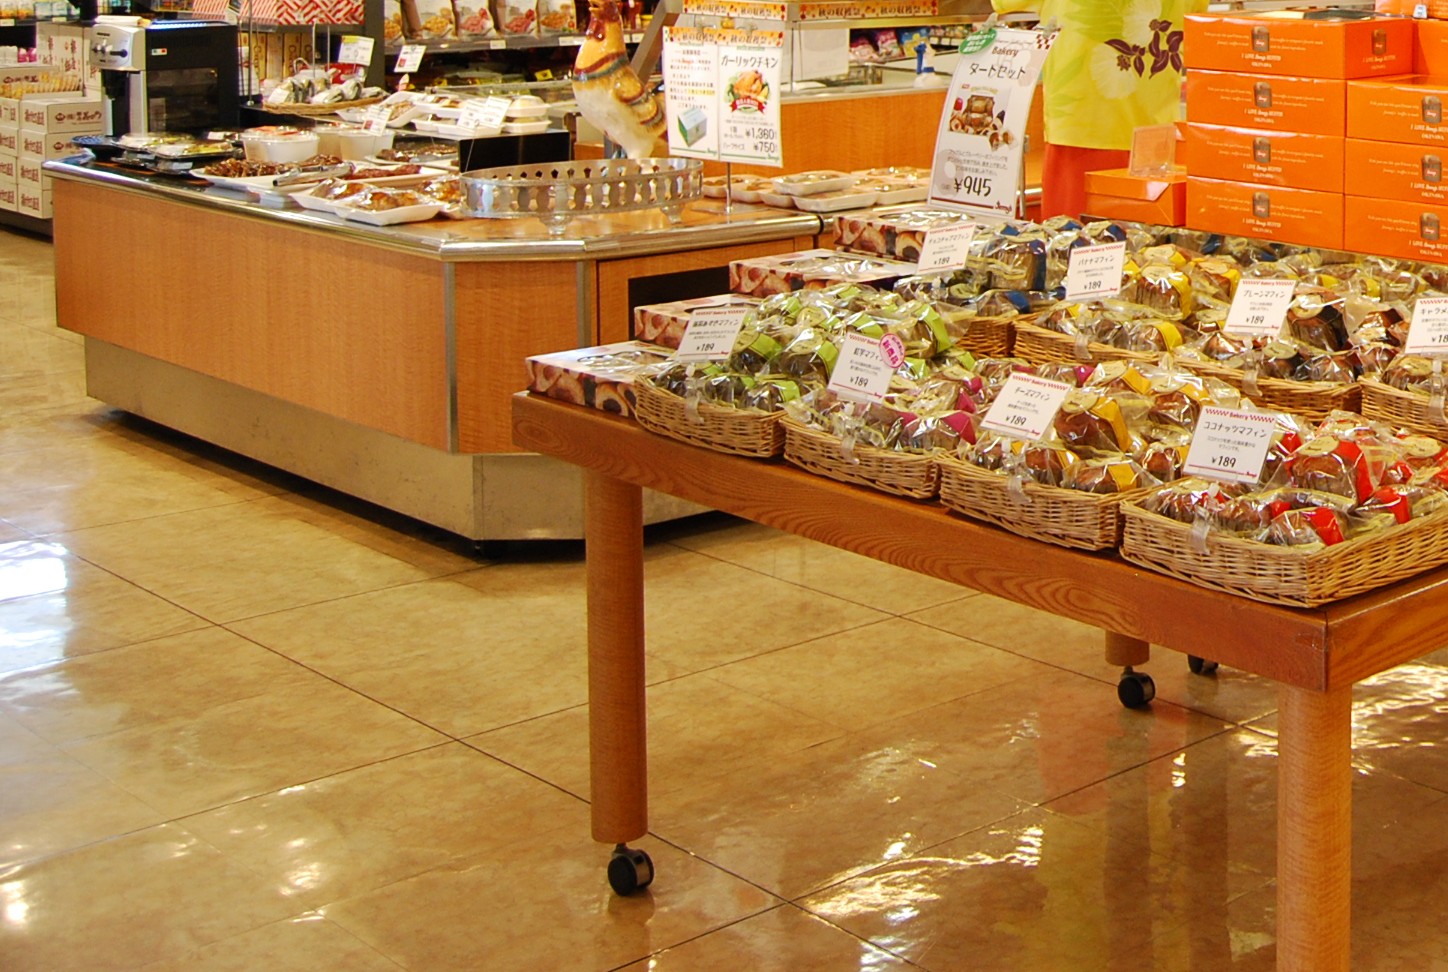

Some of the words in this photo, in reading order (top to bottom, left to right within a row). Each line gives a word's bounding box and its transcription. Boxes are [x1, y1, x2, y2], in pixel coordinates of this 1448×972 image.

[992, 46, 1019, 57] Bakery
[721, 55, 778, 68] ガーリックチキン
[969, 63, 1026, 79] タートセット
[954, 175, 992, 197] ¥945
[1243, 289, 1285, 298] プレーンマフィン
[1015, 386, 1051, 401] チーズマフィン
[1203, 421, 1267, 438] ココナッツマフィン
[1211, 455, 1237, 468] ¥189
